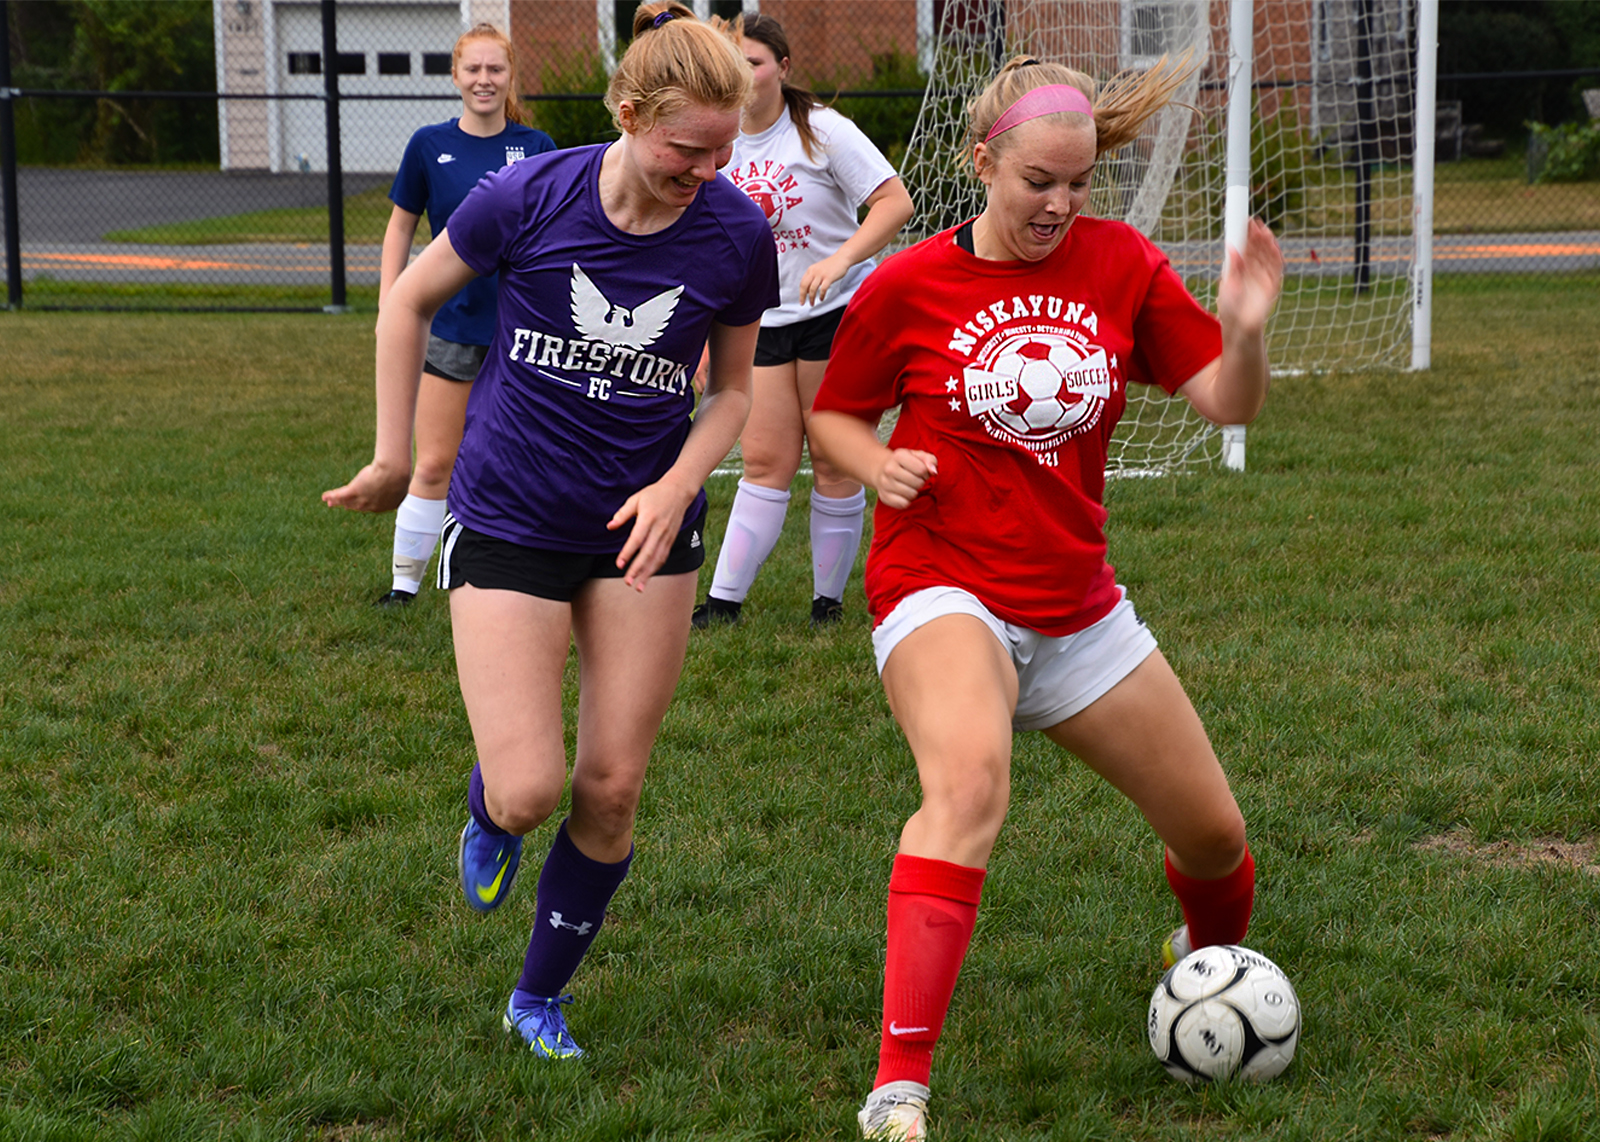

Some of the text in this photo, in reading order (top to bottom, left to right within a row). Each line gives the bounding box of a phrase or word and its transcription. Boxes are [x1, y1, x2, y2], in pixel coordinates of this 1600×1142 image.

[730, 160, 804, 211] KAYUNA
[772, 224, 812, 241] OCCER
[948, 295, 1098, 357] NISKAYUNA
[509, 328, 690, 397] FIRESTORM
[586, 377, 613, 401] FC
[968, 379, 1016, 401] GIRLS
